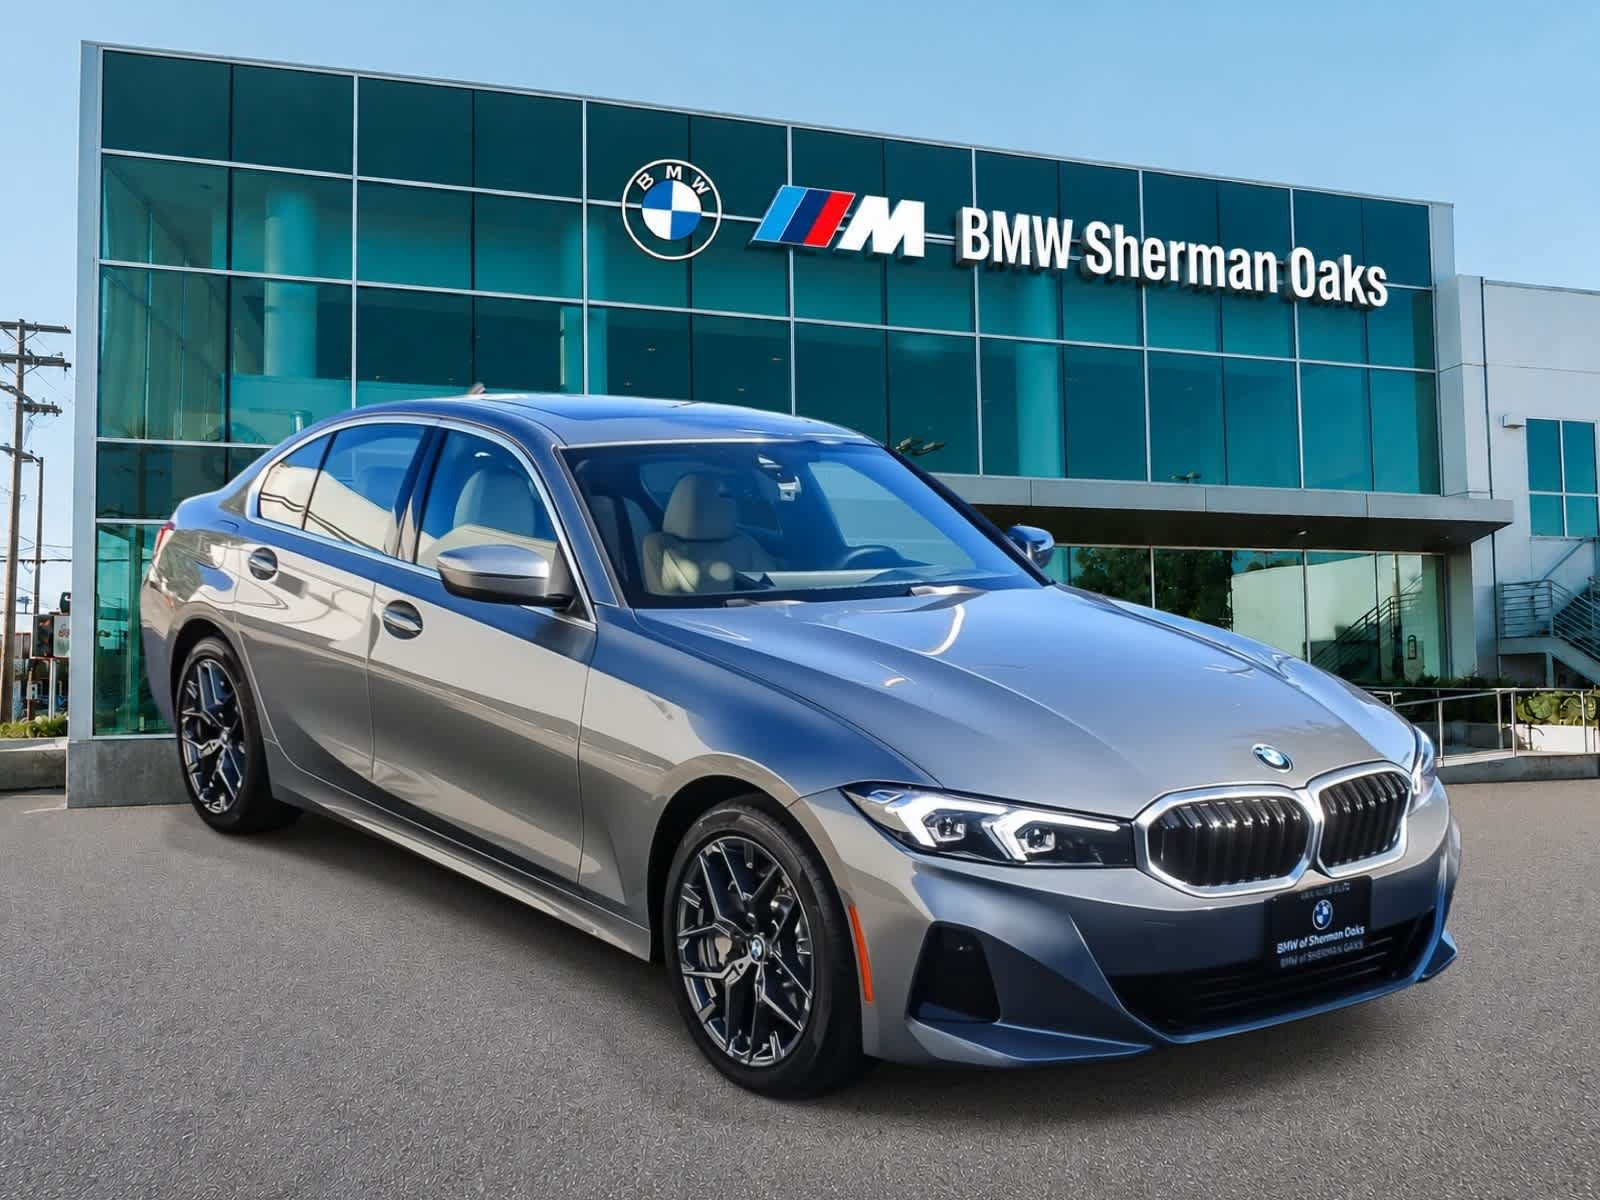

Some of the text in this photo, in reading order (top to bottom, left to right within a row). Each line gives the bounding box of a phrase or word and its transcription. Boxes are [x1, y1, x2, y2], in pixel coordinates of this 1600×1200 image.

[636, 164, 712, 196] BMW
[960, 206, 1388, 308] BMW Sherman Oaks
[1276, 924, 1366, 955] BMW of Sherman Oaks
